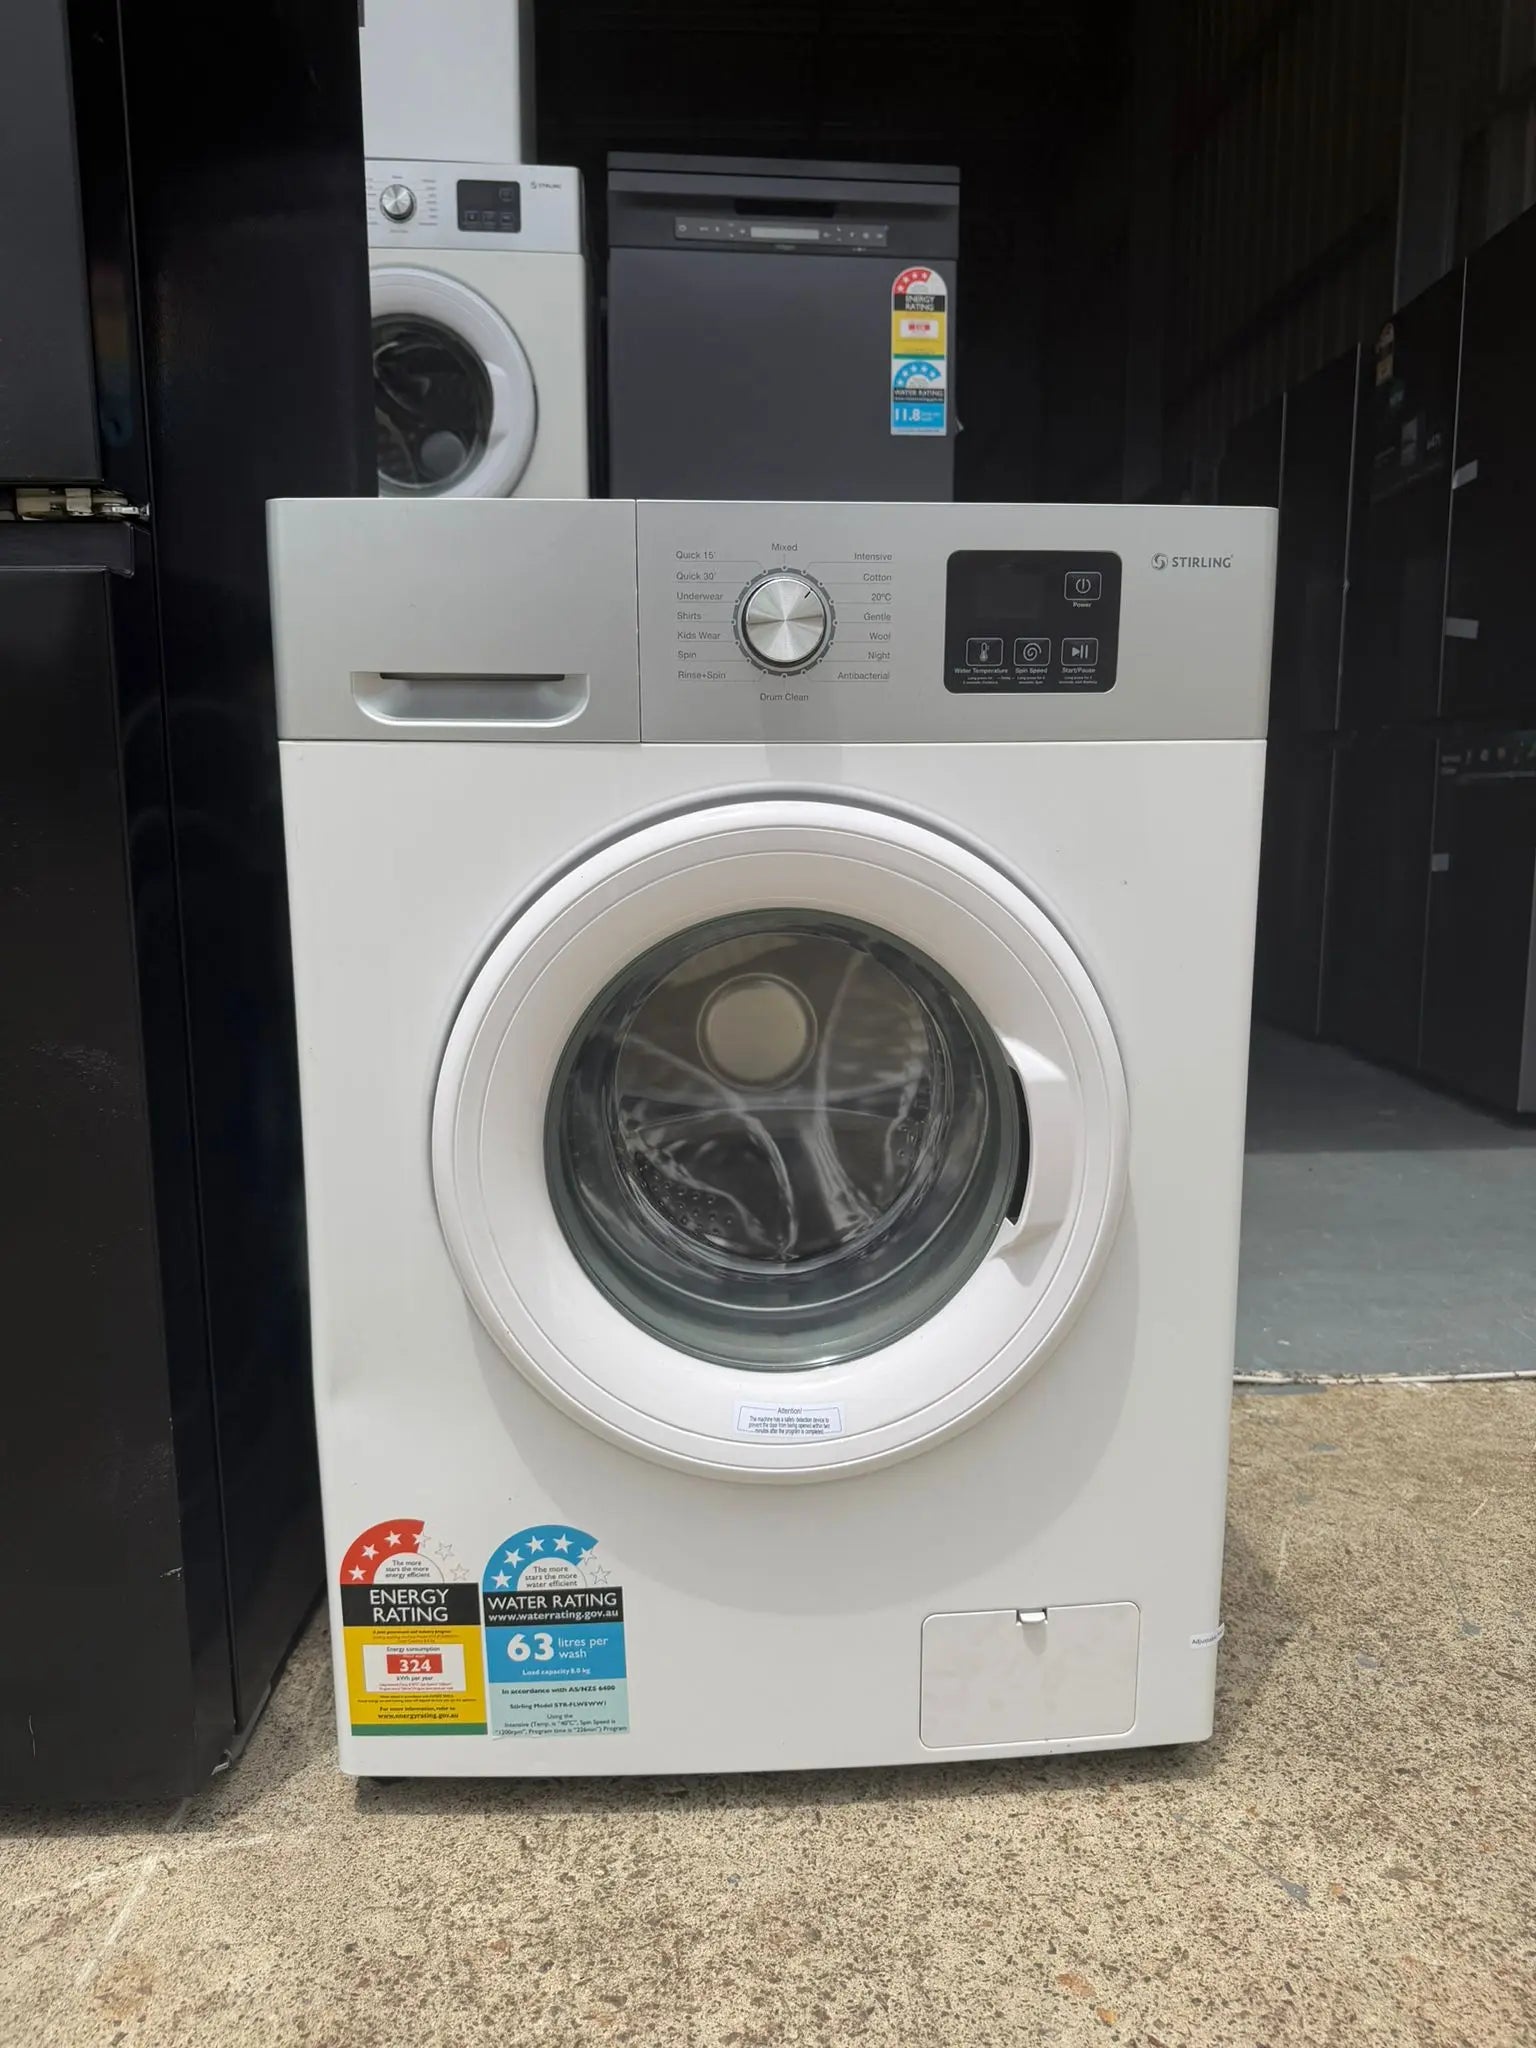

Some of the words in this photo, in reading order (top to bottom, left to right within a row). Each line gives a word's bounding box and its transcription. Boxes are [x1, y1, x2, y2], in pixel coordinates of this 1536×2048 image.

[895, 408, 920, 421] 11.8
[772, 543, 798, 552] Mixed
[676, 551, 701, 560] Quick
[854, 552, 892, 561] Intensive
[1172, 556, 1231, 568] STIRLING
[676, 572, 702, 581] Quick
[864, 574, 892, 582] Cotton
[676, 592, 724, 600] Underwear
[677, 612, 702, 620] Shirts
[864, 612, 891, 621] Gentle
[678, 632, 697, 640] Kids
[698, 632, 720, 640] Wear
[869, 632, 890, 640] Wool
[678, 650, 696, 660] Spin
[868, 651, 890, 661] Night
[678, 671, 726, 680] Rinse+Spin
[838, 672, 890, 680] Antibacterial
[760, 693, 782, 702] Drum
[784, 693, 808, 702] Clean
[370, 1588, 449, 1605] ENERGY
[488, 1596, 548, 1610] WATER
[553, 1592, 617, 1608] RATING
[373, 1607, 448, 1622] RATING
[488, 1610, 618, 1622] www.waterrating.gov.au
[507, 1632, 554, 1662] 63
[558, 1638, 586, 1648] litres
[589, 1638, 608, 1648] per
[558, 1649, 587, 1659] wash
[399, 1659, 432, 1672] 324
